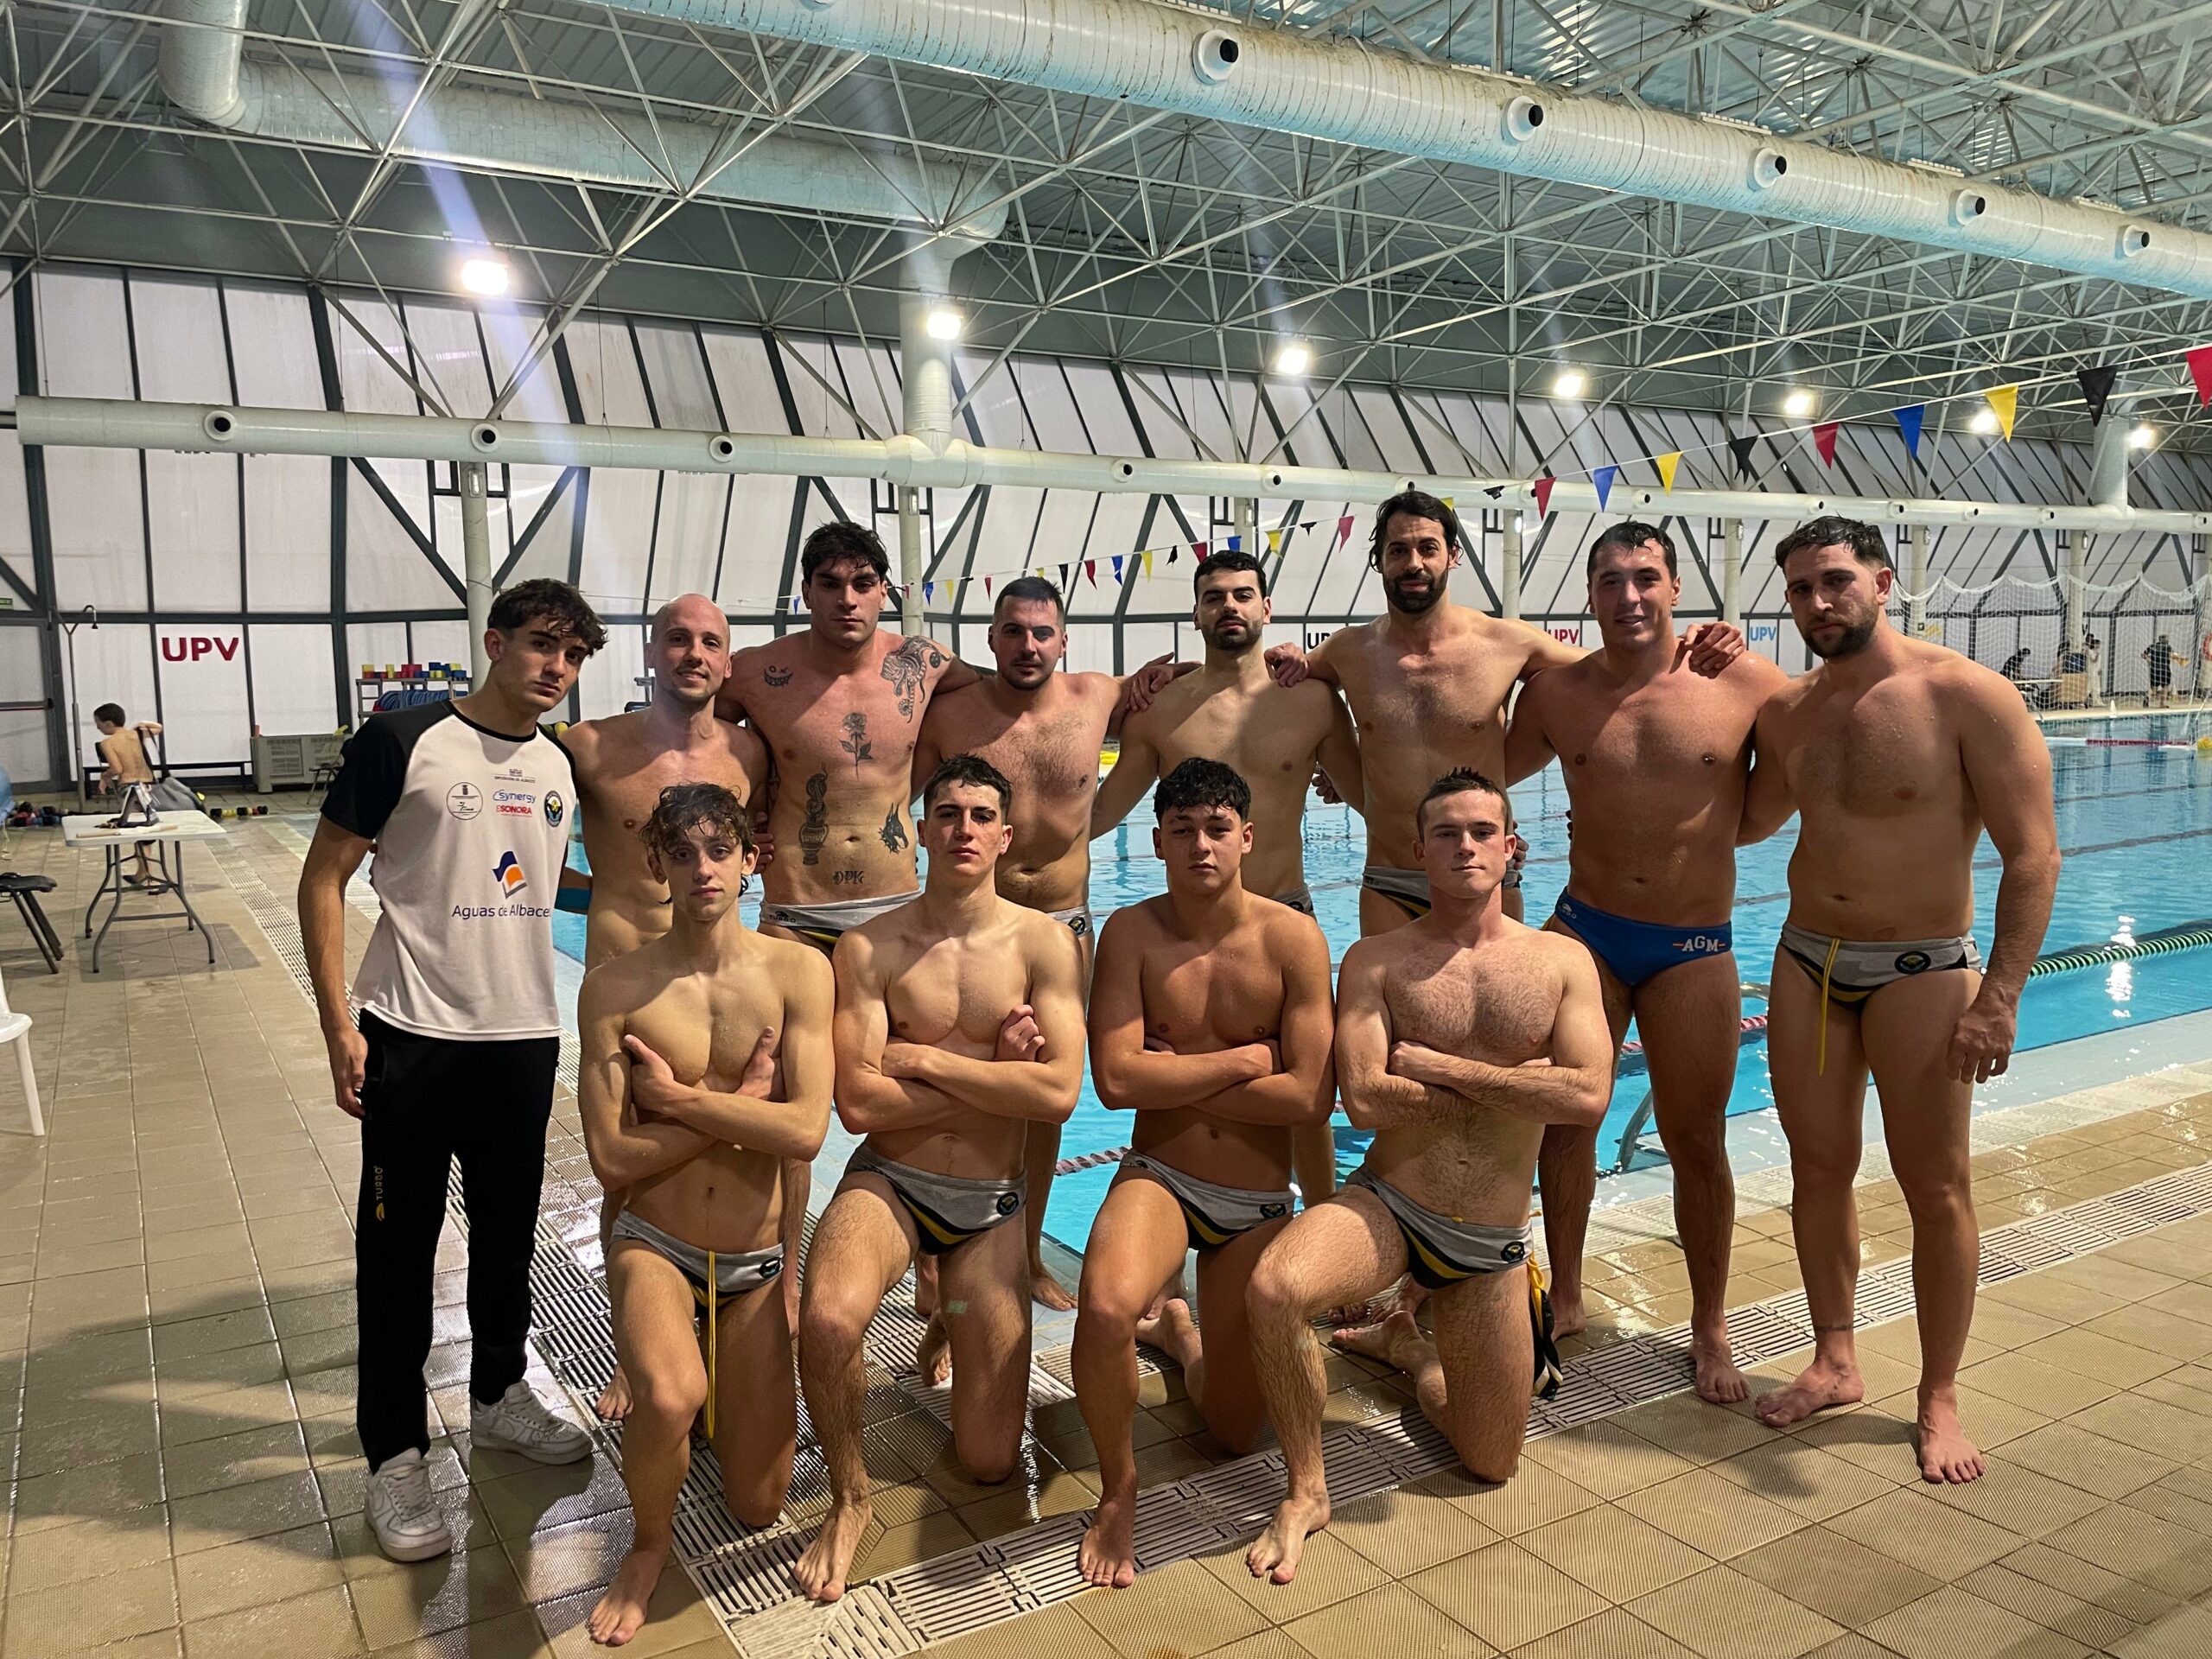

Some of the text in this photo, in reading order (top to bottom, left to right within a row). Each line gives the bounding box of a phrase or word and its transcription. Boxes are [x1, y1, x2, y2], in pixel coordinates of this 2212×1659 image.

[1750, 626, 1777, 641] UPV
[162, 637, 239, 662] UPV
[452, 905, 496, 920] Aguas
[1681, 936, 1719, 952] AGM
